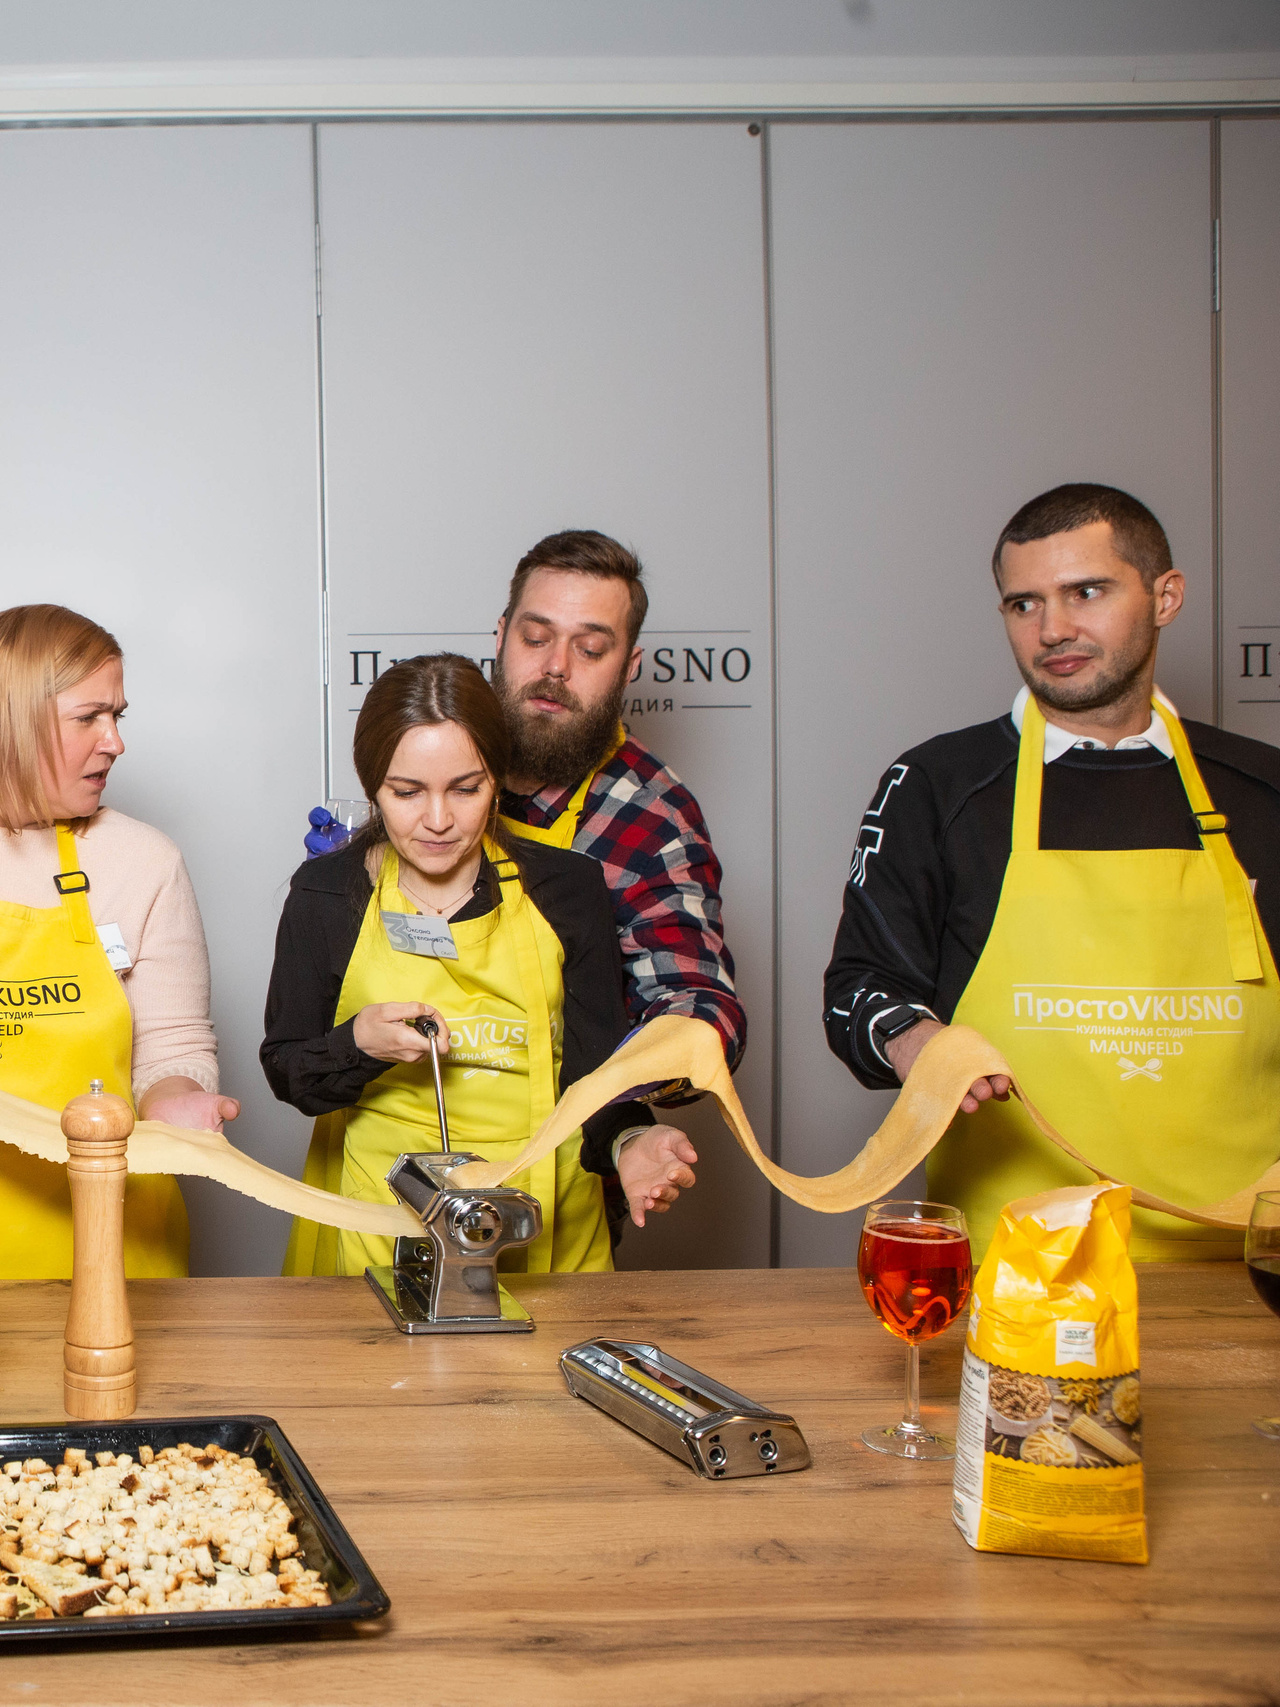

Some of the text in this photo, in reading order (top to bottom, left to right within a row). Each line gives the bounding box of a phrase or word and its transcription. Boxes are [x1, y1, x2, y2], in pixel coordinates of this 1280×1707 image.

[406, 926, 431, 934] Оксана
[1014, 992, 1243, 1022] ПростоVKUSNO
[1076, 1025, 1193, 1038] КУЛИНАРНАЯ СТУДИЯ
[1090, 1039, 1184, 1056] MAUNFELD
